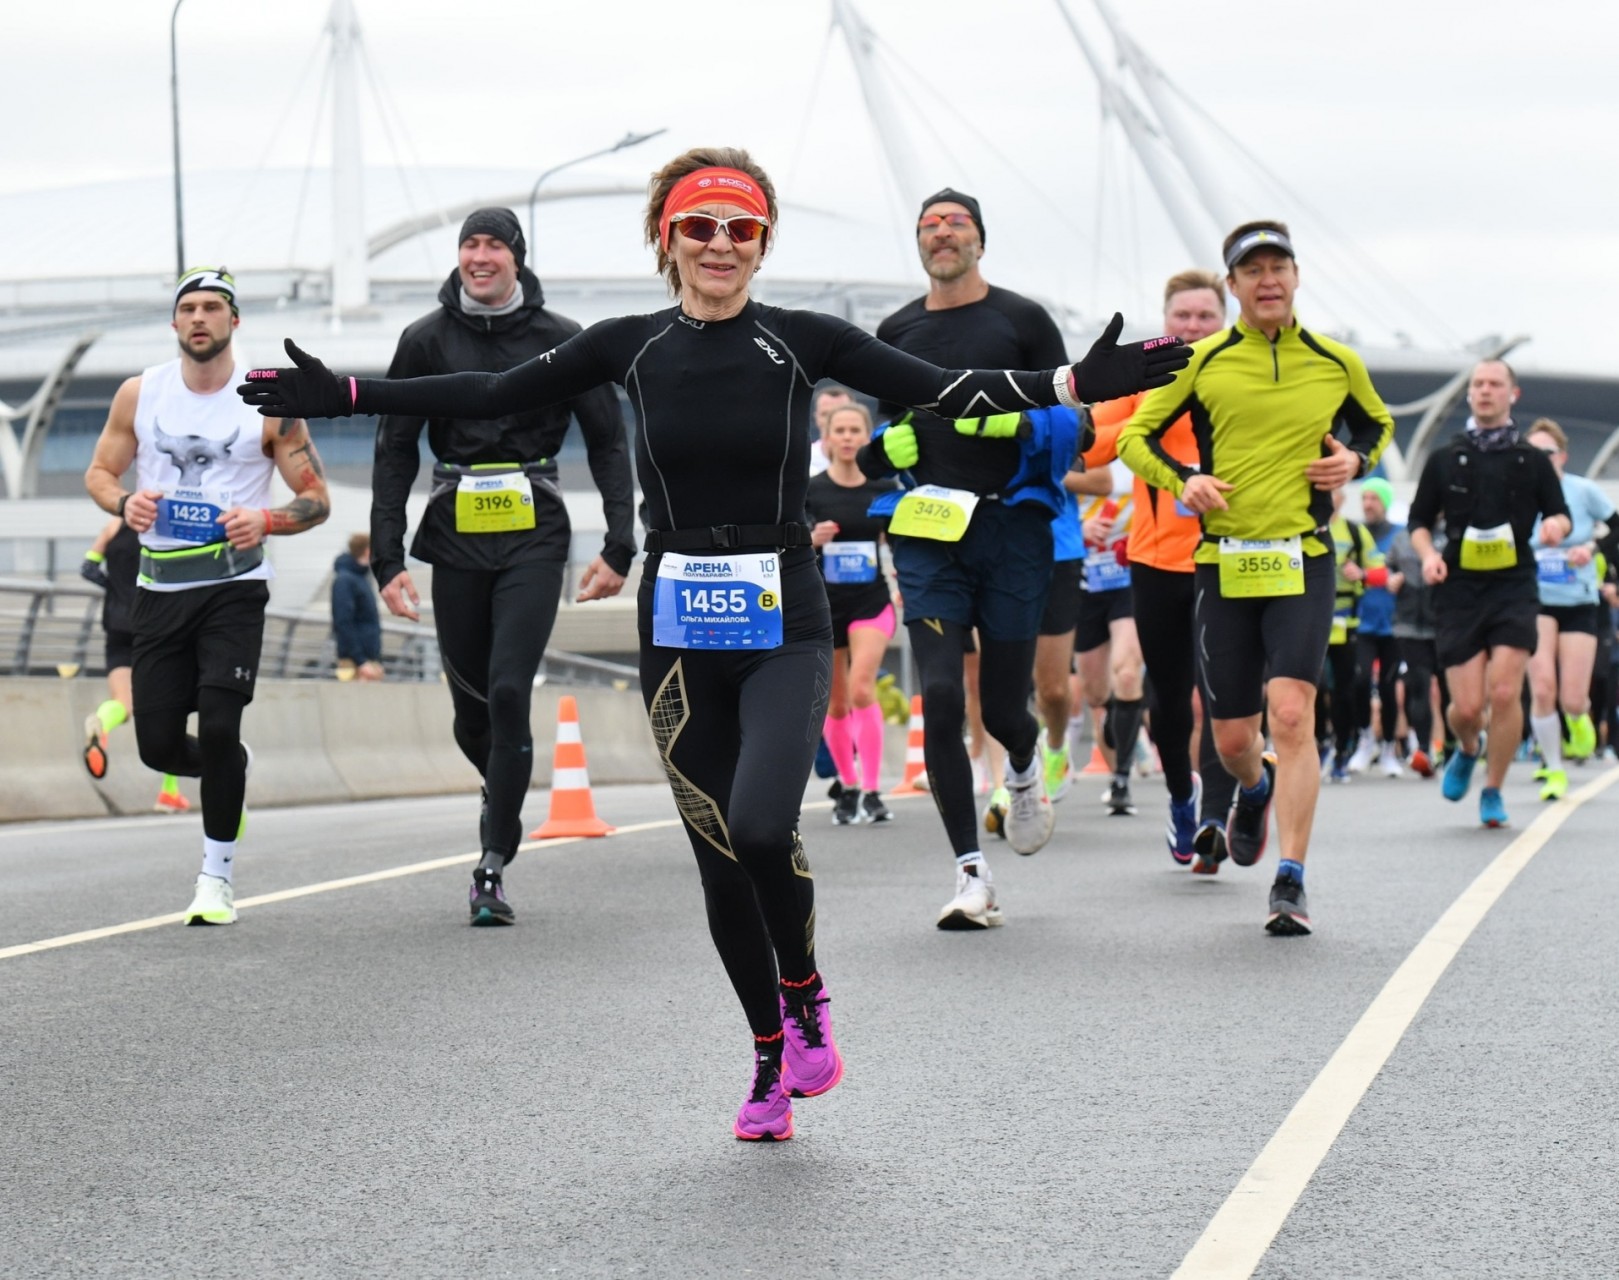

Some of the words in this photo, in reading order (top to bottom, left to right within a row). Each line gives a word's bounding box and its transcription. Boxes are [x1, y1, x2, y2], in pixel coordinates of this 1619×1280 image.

[753, 337, 785, 365] 2XU
[1143, 340, 1158, 350] JUST
[1158, 337, 1169, 346] DO
[248, 370, 261, 378] JUST
[474, 495, 513, 511] 3196
[914, 501, 952, 519] 3476
[172, 504, 211, 522] 1423
[684, 562, 732, 573] АРЕНА
[759, 560, 776, 573] 10
[1238, 557, 1282, 573] 3556
[681, 588, 747, 613] 1455
[680, 615, 704, 623] ОЛЬГА
[703, 615, 751, 624] МИХАЙЛОВА
